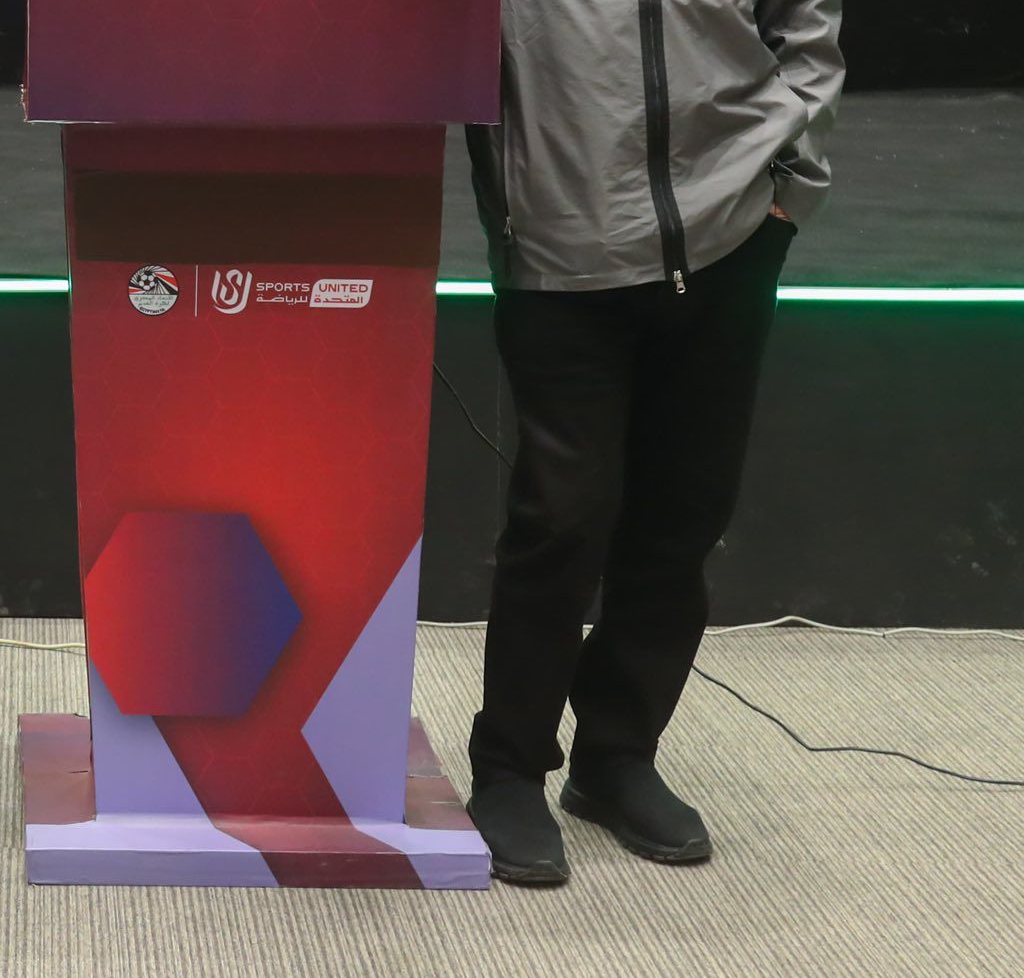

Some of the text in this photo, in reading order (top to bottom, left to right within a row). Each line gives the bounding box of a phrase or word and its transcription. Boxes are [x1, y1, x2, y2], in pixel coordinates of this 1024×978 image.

[256, 282, 369, 293] SPORTS UNITED
[256, 293, 364, 306] المتحدة للرياضة
